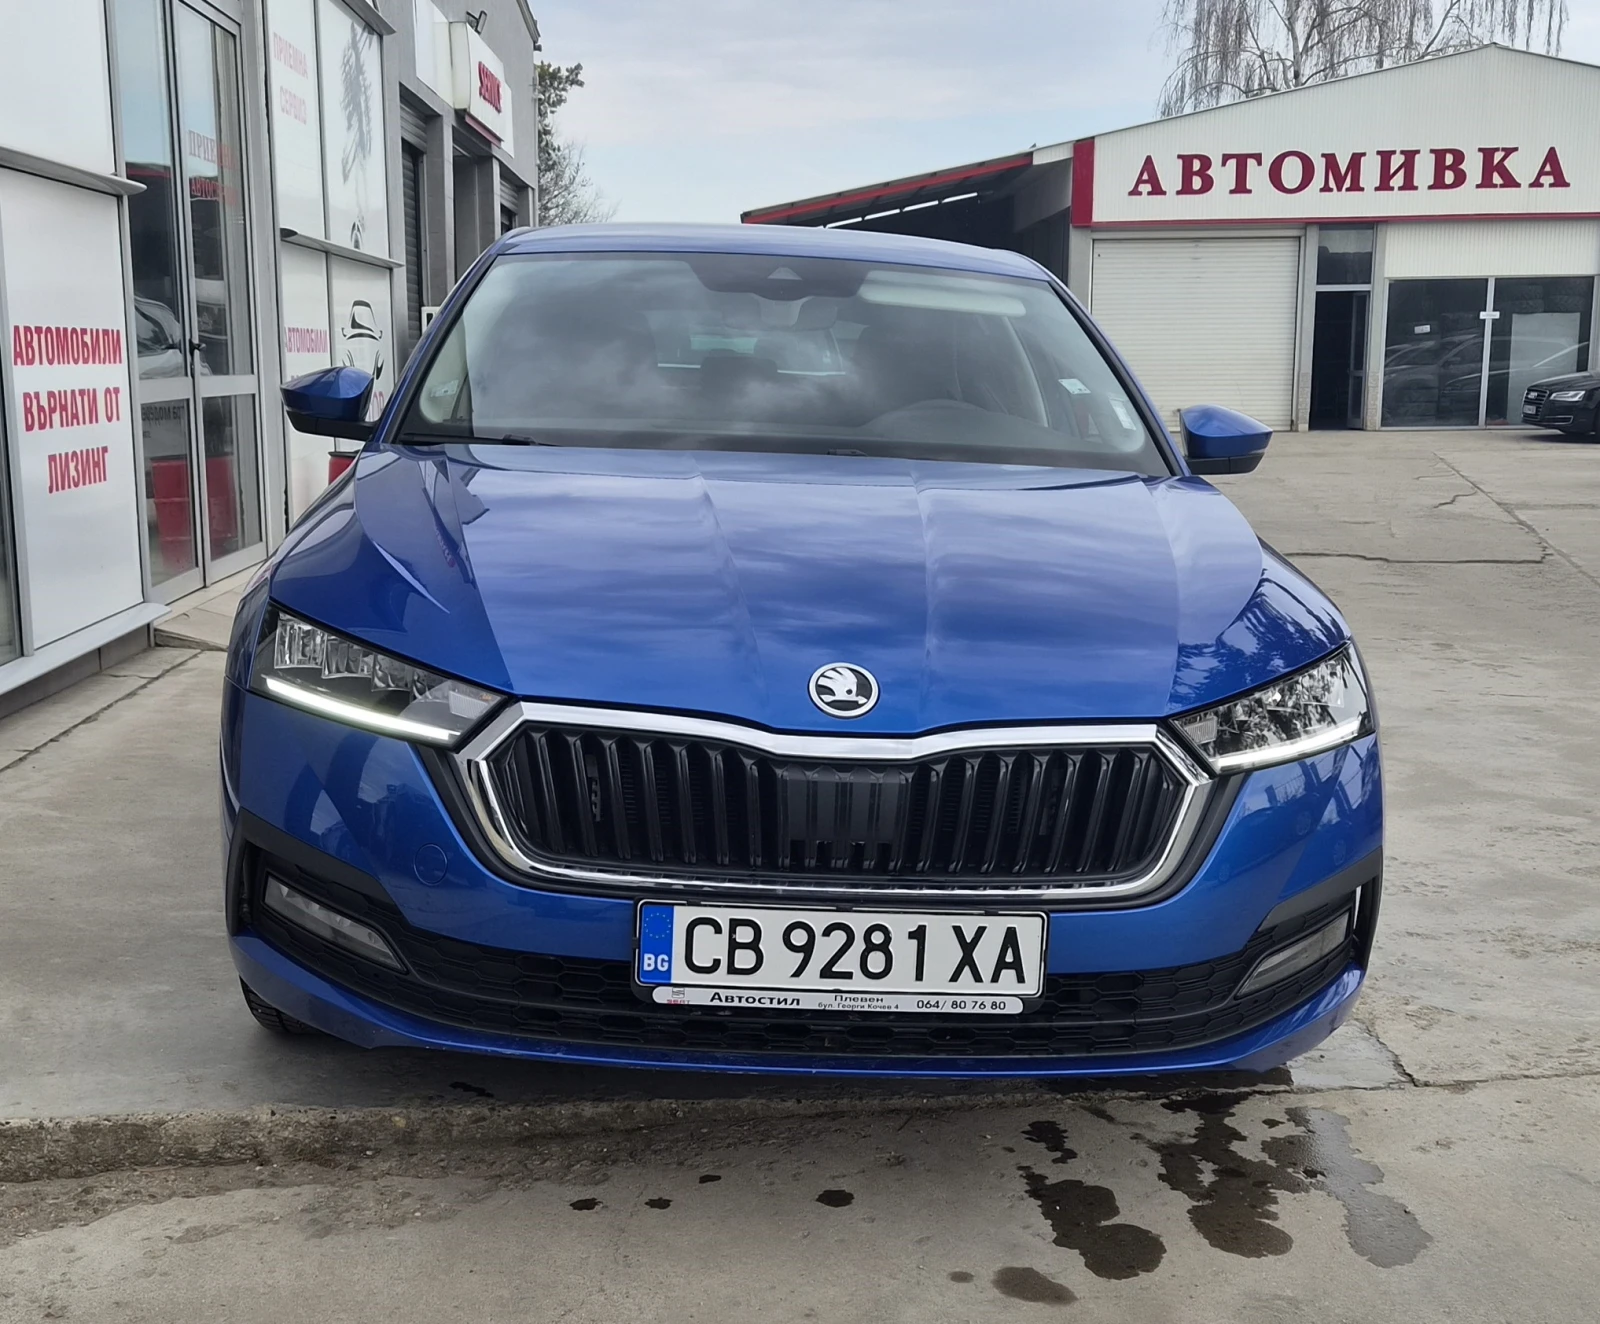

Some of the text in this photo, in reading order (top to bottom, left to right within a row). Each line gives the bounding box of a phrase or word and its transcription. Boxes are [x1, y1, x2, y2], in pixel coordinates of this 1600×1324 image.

[1128, 146, 1571, 196] АВТОМИВКА
[13, 325, 122, 366] АВТОМОБИЛИ
[22, 387, 120, 432] ВЪРНАТИ ОТ
[47, 446, 108, 494] ЛИЗИНГ
[643, 953, 669, 972] BG
[782, 920, 927, 982] 9281
[709, 991, 801, 1007] Автостил
[817, 1002, 834, 1010] бул.
[837, 1002, 865, 1011] Георги
[834, 994, 884, 1003] Плевен
[916, 999, 1006, 1011] 064/ 80 76 80
